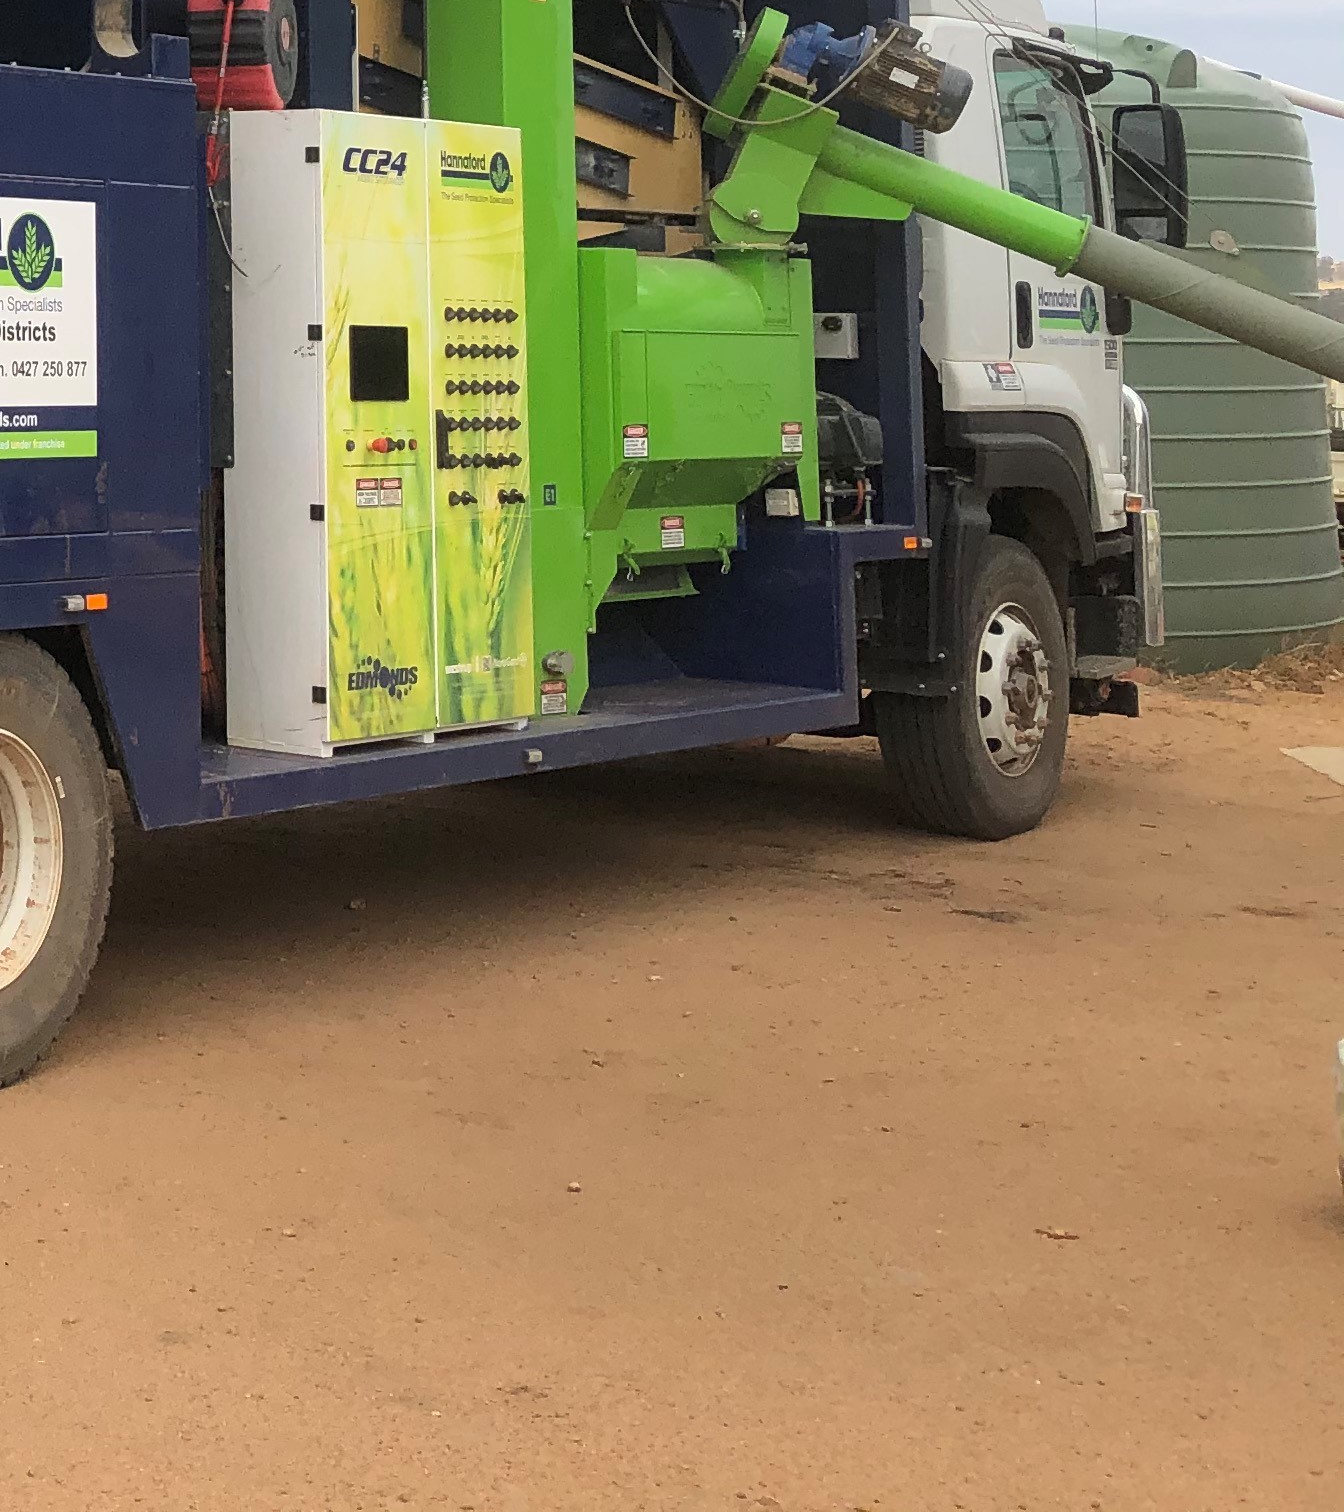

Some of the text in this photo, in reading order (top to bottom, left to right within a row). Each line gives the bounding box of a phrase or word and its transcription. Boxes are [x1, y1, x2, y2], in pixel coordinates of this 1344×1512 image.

[342, 147, 407, 176] CC24
[440, 150, 486, 170] Hannaford
[7, 296, 63, 315] Specialists
[1037, 286, 1078, 309] Hannaford
[11, 361, 39, 378] 0427
[42, 361, 63, 378] 250
[66, 361, 87, 378] 877
[32, 439, 65, 450] franchise
